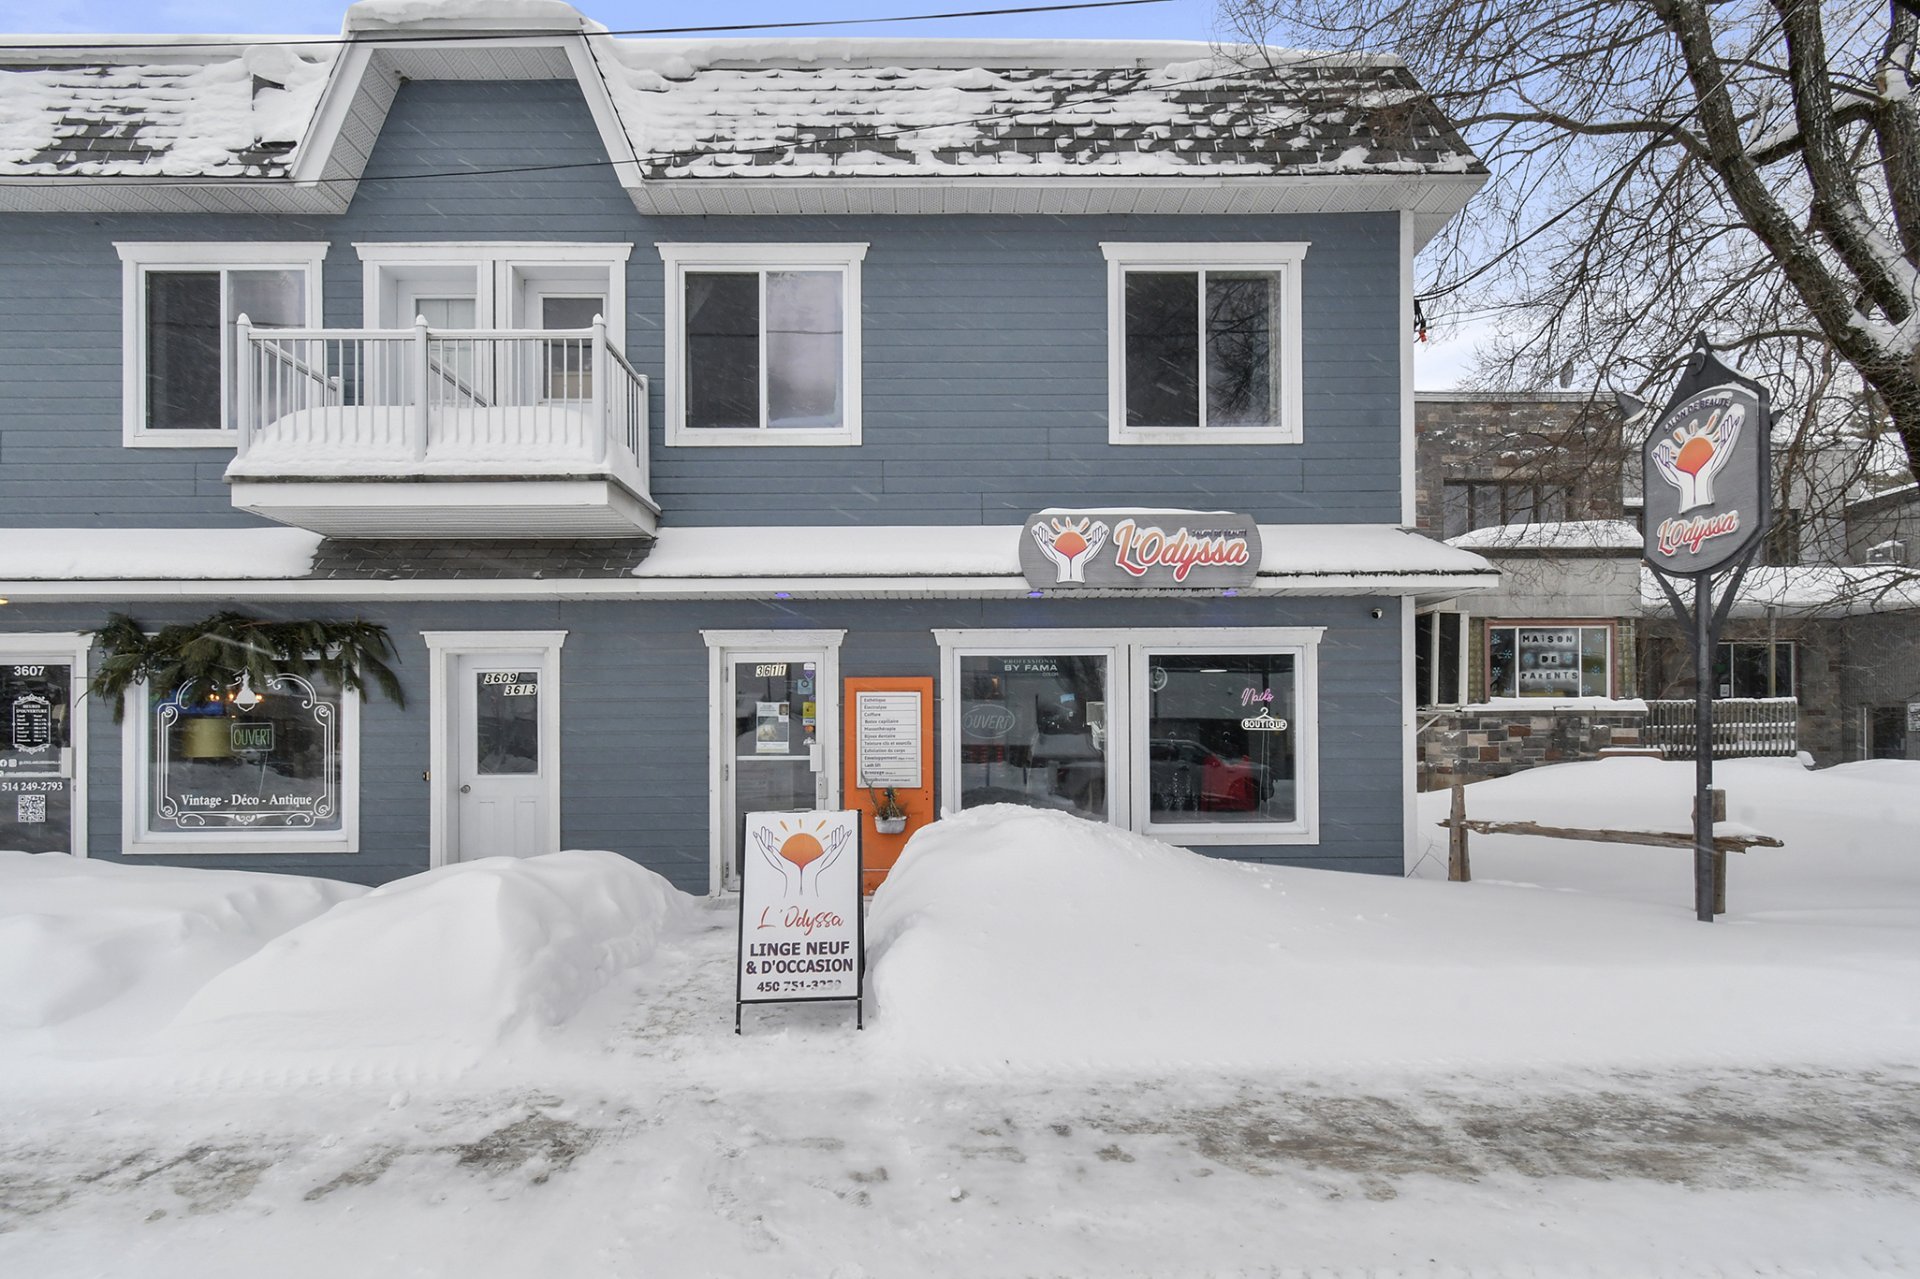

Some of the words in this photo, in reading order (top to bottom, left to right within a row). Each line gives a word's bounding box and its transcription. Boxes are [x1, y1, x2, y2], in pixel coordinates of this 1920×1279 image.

[1657, 510, 1740, 556] L'Odyssa
[1113, 518, 1250, 583] L'Odyssa
[1541, 655, 1557, 663] DE
[14, 665, 45, 676] 3607
[756, 665, 787, 677] 3611
[485, 672, 517, 684] 3609
[505, 684, 537, 695] 3613
[1241, 687, 1274, 706] Nails
[964, 715, 1012, 729] OUVERT
[1244, 720, 1286, 729] BOUTIQUE
[233, 728, 272, 746] OUVERT
[1, 782, 19, 791] 514
[21, 781, 63, 791] 249-2793
[181, 794, 222, 808] Vintage
[231, 794, 260, 806] Déco
[269, 794, 313, 808] Antique
[750, 942, 801, 957] LINGE
[806, 941, 850, 956] NEUF
[746, 961, 757, 975] &
[761, 958, 853, 974] D'OCCASION
